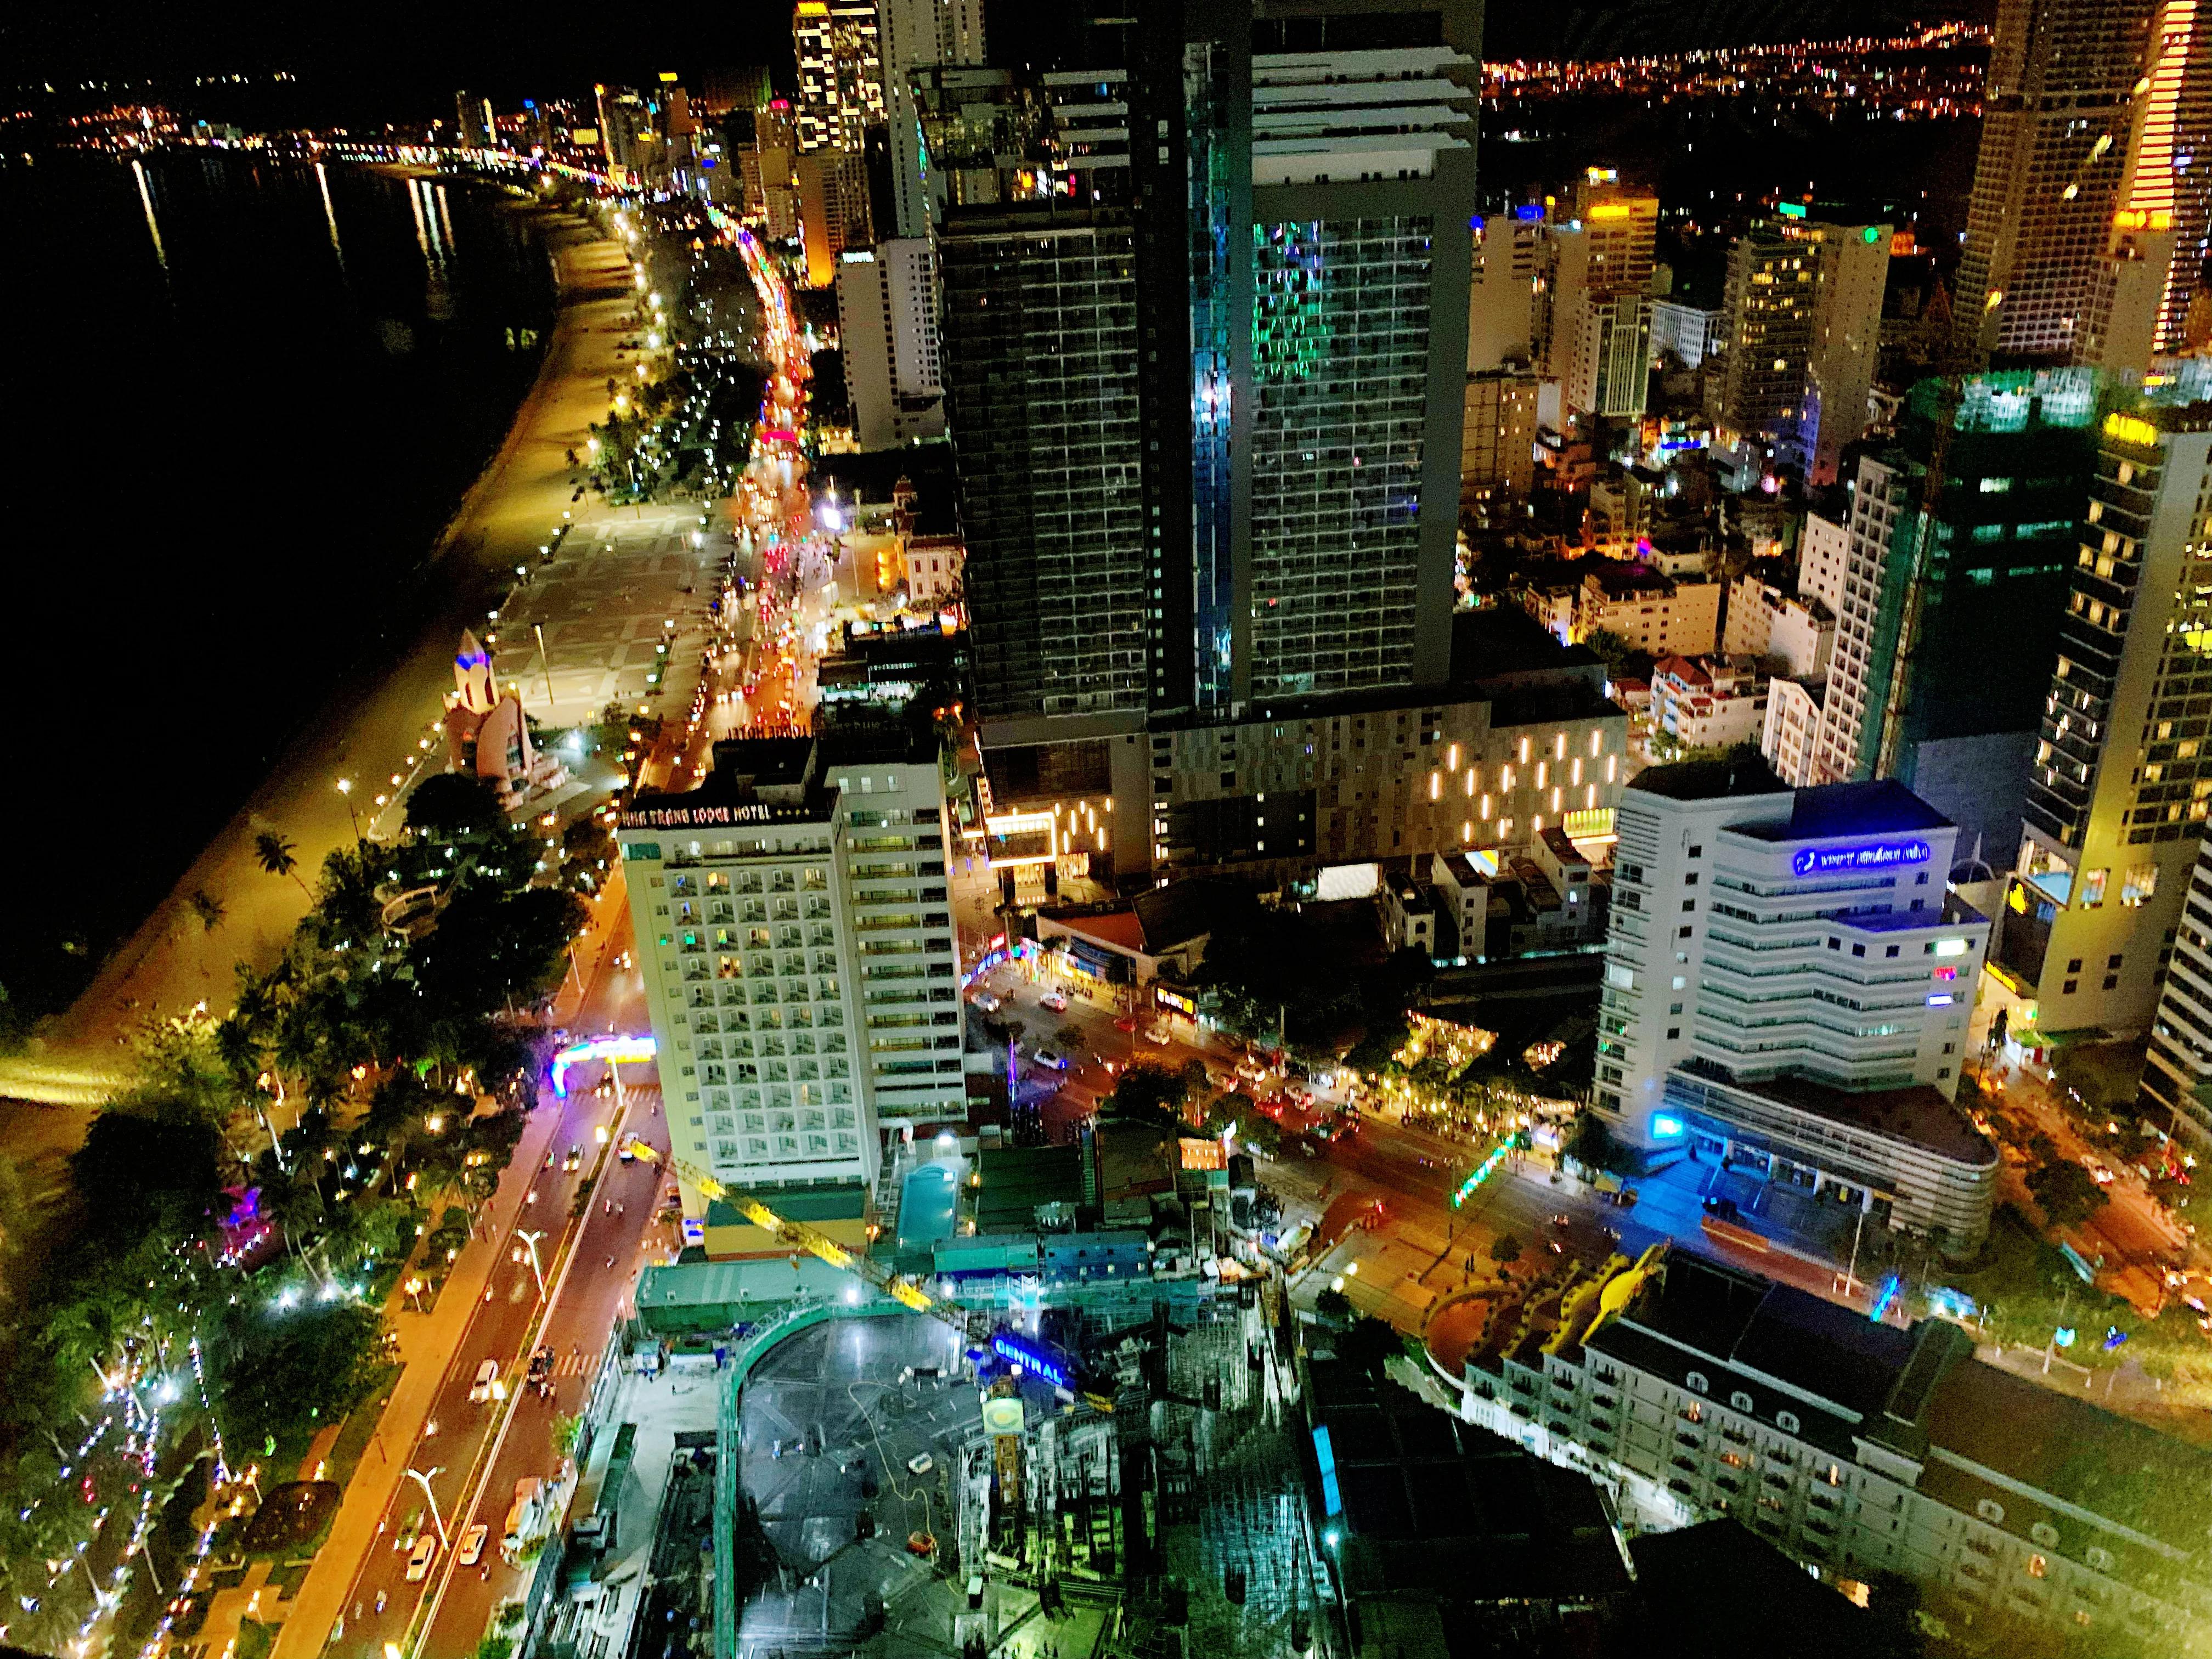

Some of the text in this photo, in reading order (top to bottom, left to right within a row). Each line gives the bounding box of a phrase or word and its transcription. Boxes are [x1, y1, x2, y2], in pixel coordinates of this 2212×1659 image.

[650, 808, 690, 826] TRANG
[693, 806, 730, 824] LODGE
[734, 804, 771, 822] HOTEL
[995, 1339, 1063, 1385] CENTRAL
